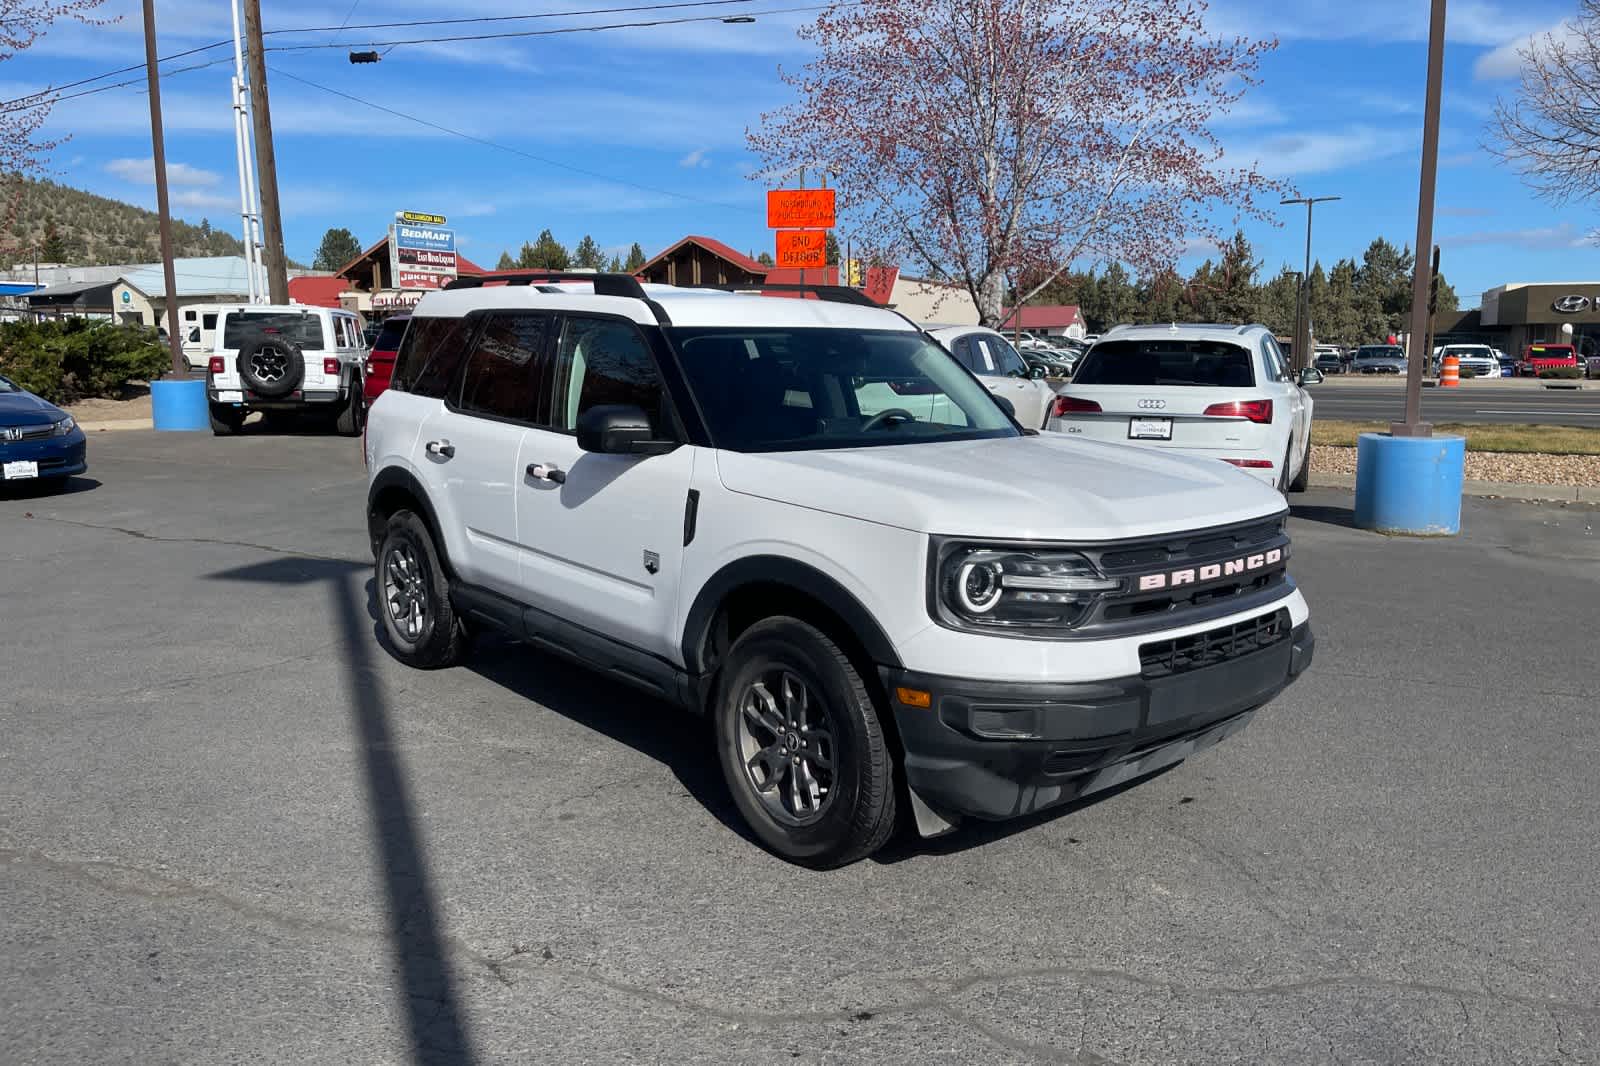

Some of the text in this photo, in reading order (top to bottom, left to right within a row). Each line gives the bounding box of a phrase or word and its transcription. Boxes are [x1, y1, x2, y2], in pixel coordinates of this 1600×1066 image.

[792, 235, 810, 247] END
[783, 251, 819, 262] DETOUR
[1139, 549, 1281, 590] BRONCO
